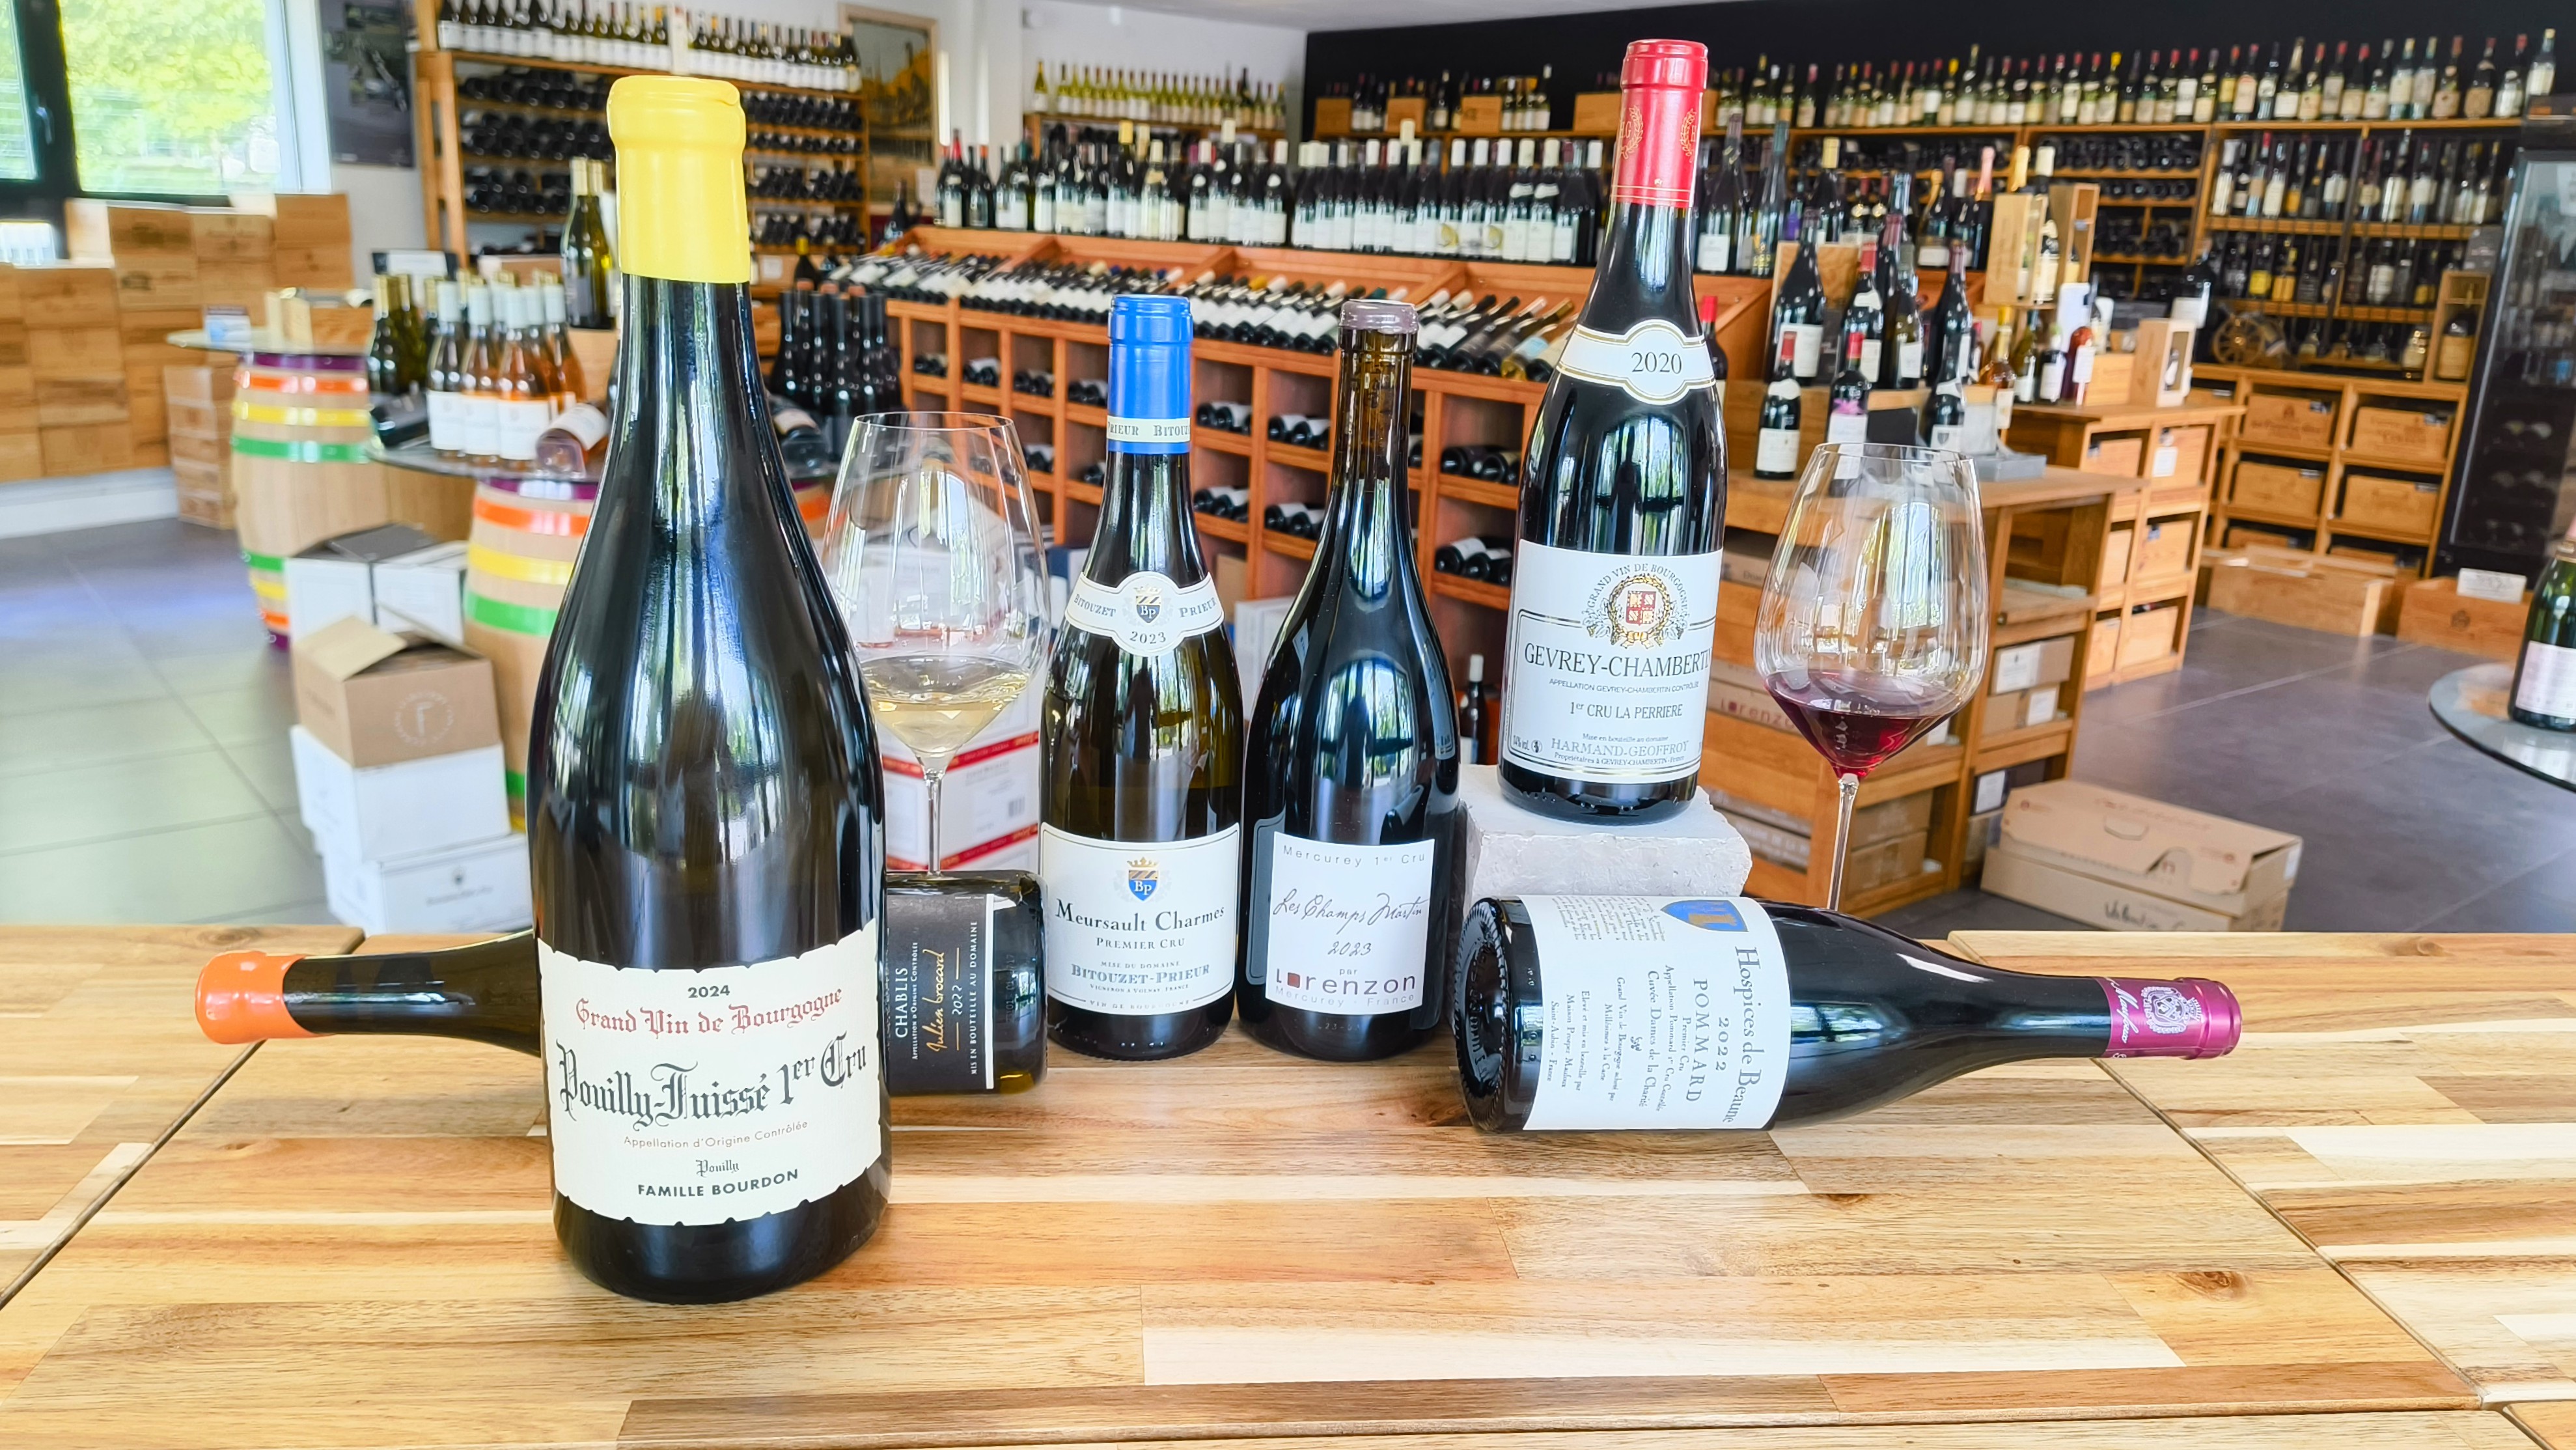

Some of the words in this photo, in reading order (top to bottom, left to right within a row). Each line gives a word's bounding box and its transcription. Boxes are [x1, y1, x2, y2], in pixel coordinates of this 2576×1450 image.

[1631, 351, 1682, 374] 2020
[1587, 575, 1612, 608] GRAND
[1612, 565, 1631, 577] VIN
[1635, 563, 1648, 572] DE
[1651, 564, 1688, 611] BOURGOGNE
[1073, 593, 1116, 617] BITOUZET
[1178, 596, 1216, 618] PRIEUR
[1129, 630, 1167, 644] 2023
[1549, 678, 1594, 691] APPELLATION
[1570, 702, 1584, 714] 1er
[1586, 704, 1613, 718] CRU
[1616, 706, 1630, 719] LA
[1635, 704, 1683, 719] PERRIERE
[1551, 738, 1689, 757] HARMAND-GEOFFROY
[1283, 844, 1362, 867] Mercurey
[1401, 852, 1425, 864] Cru
[1055, 898, 1146, 932] Meursault
[1155, 906, 1225, 931] Charmes
[1273, 888, 1301, 915] Les
[1301, 895, 1365, 935] Champs
[1367, 892, 1431, 925] Martin
[1096, 937, 1156, 949] PREMIER
[1160, 938, 1185, 949] CRU
[1327, 941, 1372, 956] 2023
[969, 973, 976, 986] AU
[1071, 964, 1210, 984] BITOUZET-PRIEUR
[687, 984, 730, 998] 2024
[1275, 986, 1344, 1007] Mercurey
[1367, 994, 1415, 1007] France
[1616, 977, 1627, 1001] Grand
[1648, 971, 1660, 1003] Cuvée
[1663, 965, 1676, 1011] Appellation
[1732, 946, 1762, 1037] Hospices
[895, 968, 908, 1038] CHABLIS
[952, 985, 963, 1015] 2022
[1618, 1005, 1627, 1019] Vin
[576, 998, 637, 1033] Grand
[641, 1007, 689, 1039] Vin
[699, 1012, 723, 1033] de
[729, 988, 842, 1035] Bourgogne
[1550, 1001, 1560, 1049] Saint-Aubin
[1618, 1022, 1627, 1030] de
[1650, 1007, 1662, 1045] Dames
[1668, 1014, 1678, 1052] Pommard
[1682, 1016, 1692, 1051] Premier
[1614, 1034, 1627, 1069] Bourgogne
[1685, 979, 1710, 1102] POMMARD
[1715, 1017, 1730, 1072] 2022
[970, 1048, 976, 1058] EN
[1648, 1049, 1660, 1061] de
[1678, 1055, 1690, 1072] Cru
[1741, 1042, 1764, 1065] de
[777, 1055, 815, 1105] 1er
[820, 1031, 866, 1089] Cru
[1647, 1065, 1659, 1073] la
[1664, 1067, 1675, 1081] Cru
[1639, 1076, 1657, 1108] Charité
[1723, 1069, 1762, 1123] Beaune
[624, 1136, 689, 1149] Appellation
[693, 1134, 750, 1149] d'Origine
[755, 1121, 809, 1141] Contrôlée
[695, 1159, 740, 1178] Pouilly
[638, 1184, 704, 1197] FAMILLE
[712, 1169, 799, 1197] BOURDON
